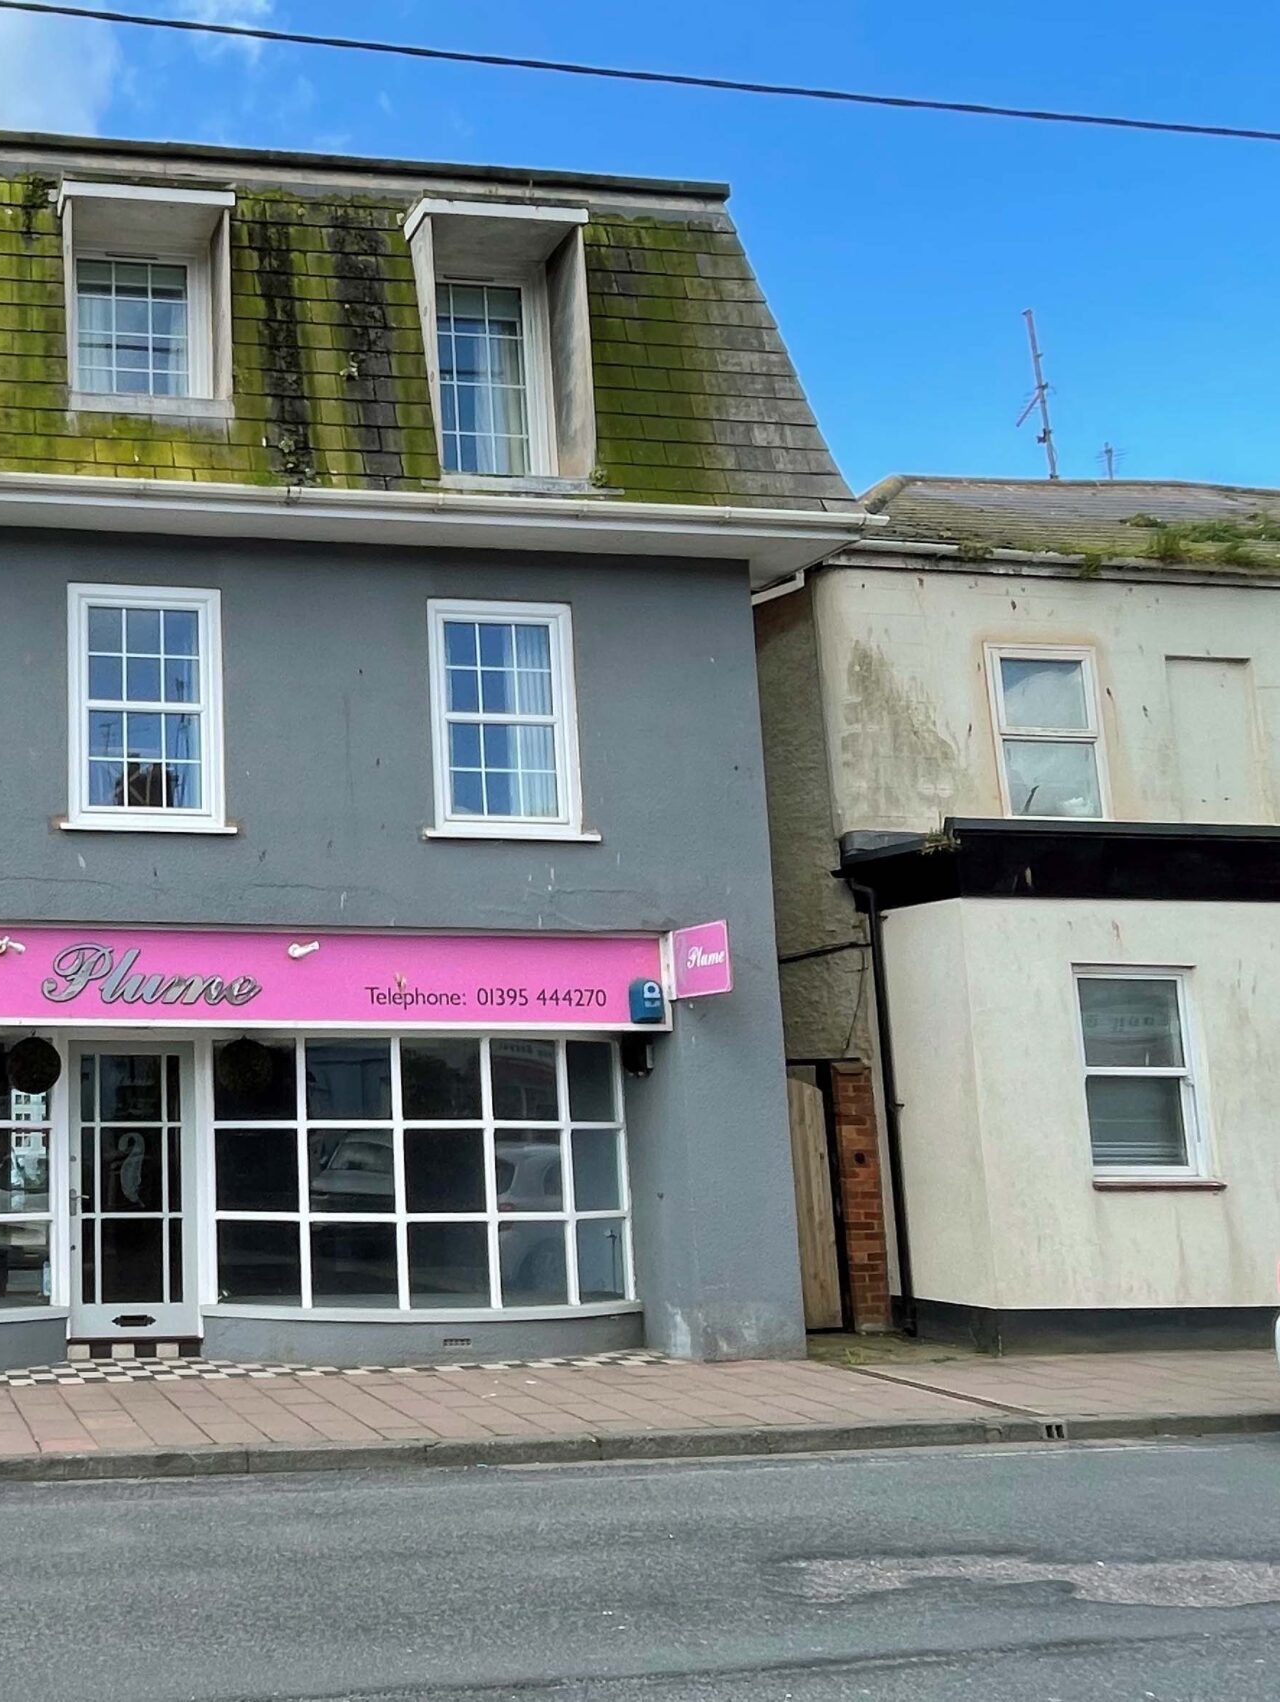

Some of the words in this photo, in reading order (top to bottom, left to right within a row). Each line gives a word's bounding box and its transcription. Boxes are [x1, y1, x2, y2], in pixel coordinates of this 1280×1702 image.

[41, 942, 262, 1006] Plume
[364, 986, 467, 1010] Telephone:
[476, 987, 529, 1006] 01395
[535, 988, 607, 1007] 444270
